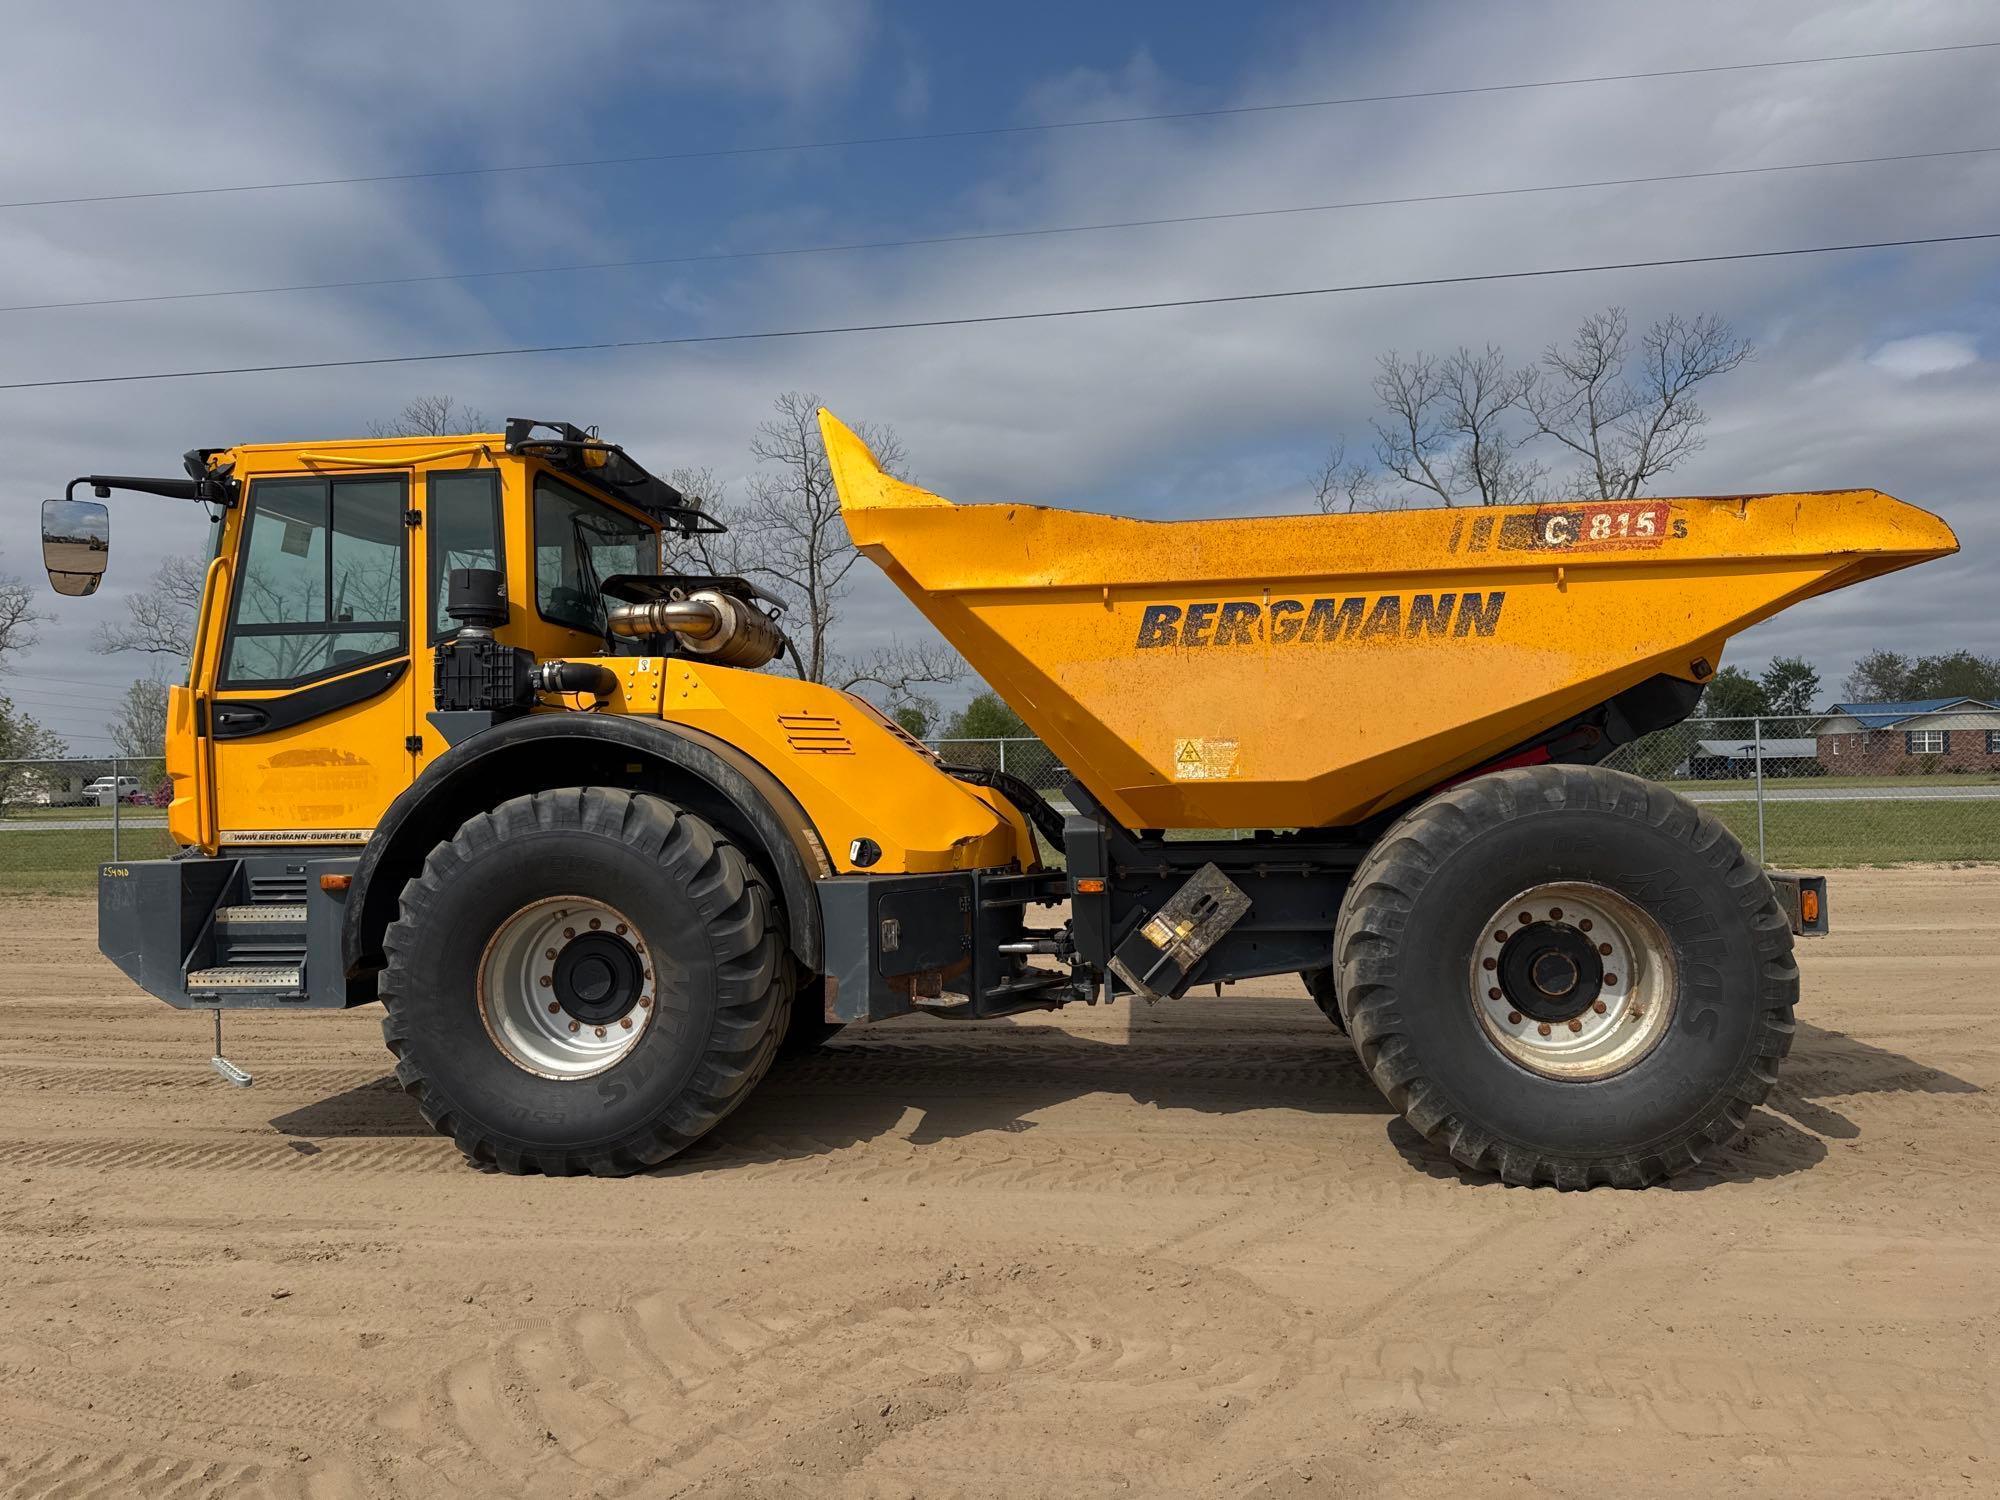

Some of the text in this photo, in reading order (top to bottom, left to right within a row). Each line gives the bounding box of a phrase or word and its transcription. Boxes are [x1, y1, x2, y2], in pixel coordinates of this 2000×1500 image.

[1545, 516, 1569, 544] C
[1589, 512, 1656, 540] 815
[1135, 591, 1506, 648] BERGMANN
[234, 833, 362, 841] WWW.BERGMANN-DUMPER.DE
[103, 866, 129, 877] 254010
